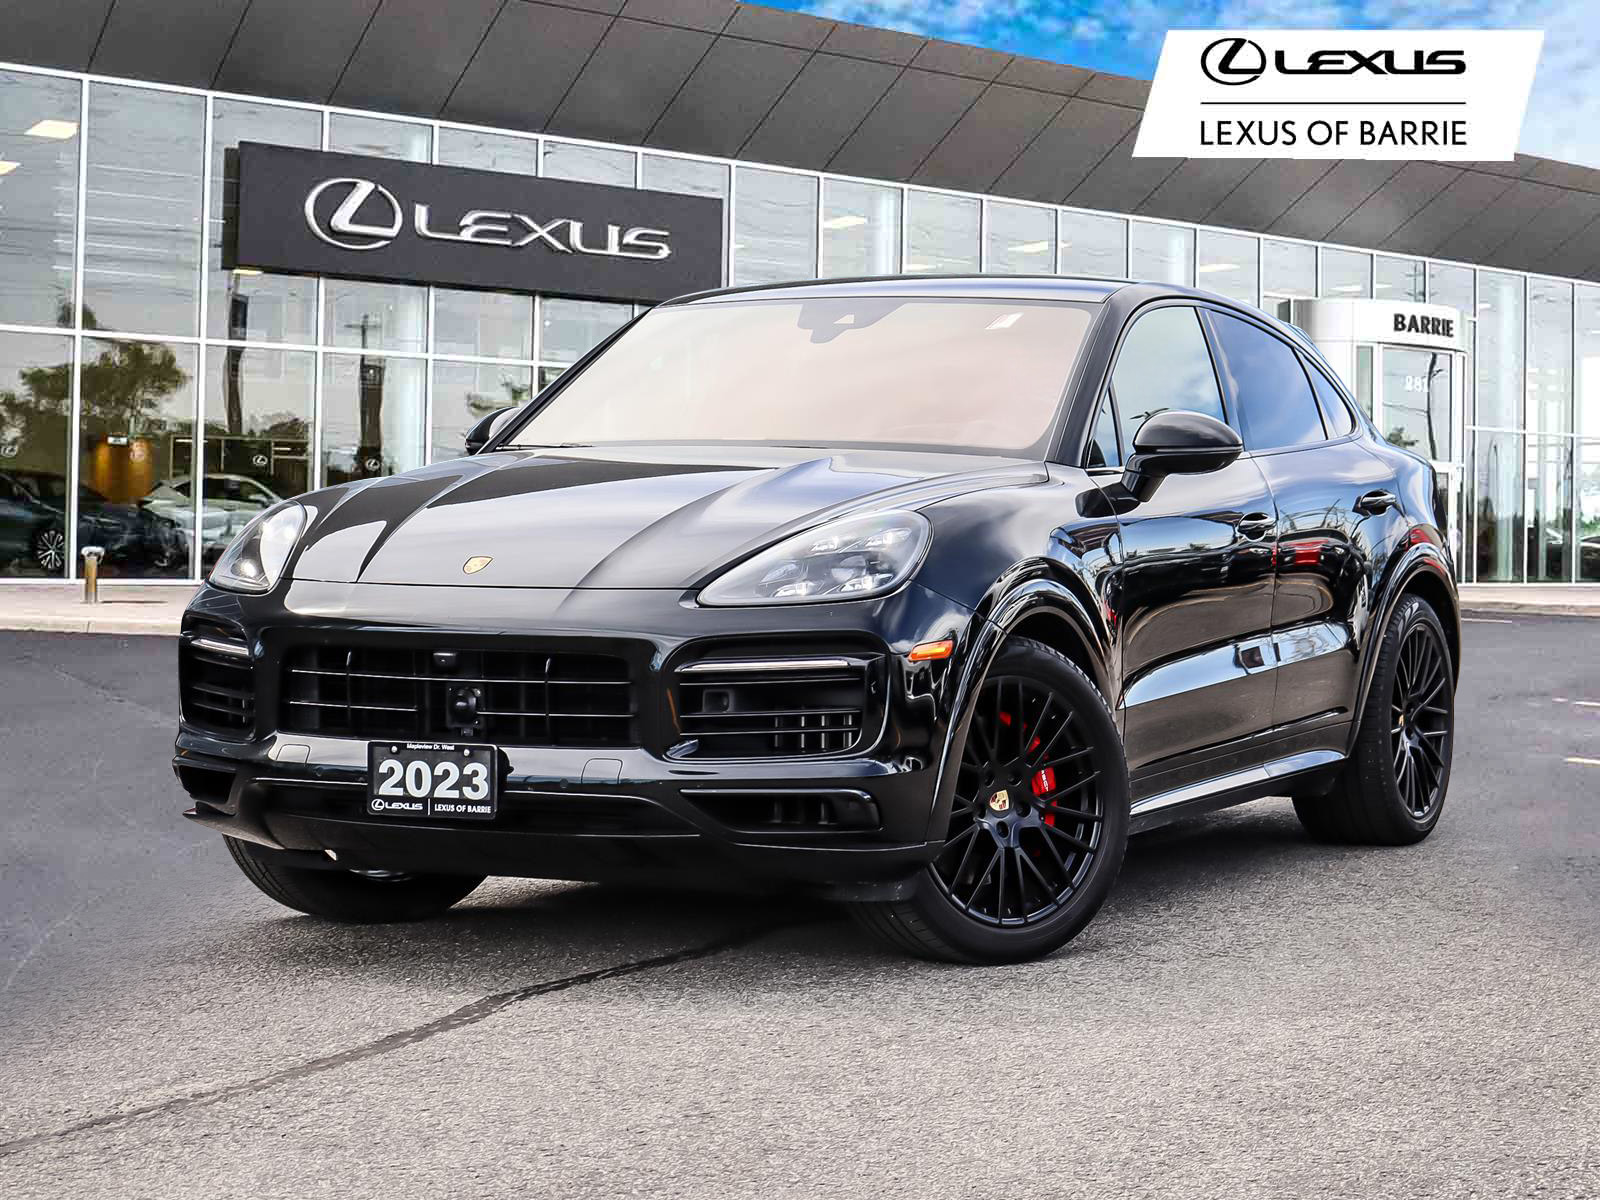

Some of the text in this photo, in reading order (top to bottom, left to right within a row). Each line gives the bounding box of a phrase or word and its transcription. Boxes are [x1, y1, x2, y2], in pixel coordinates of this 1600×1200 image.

[415, 204, 672, 259] LEXUS
[1393, 313, 1454, 338] BARRIE
[378, 759, 489, 800] 2023
[385, 802, 423, 810] LEXUS
[435, 804, 455, 812] LEXUS
[468, 805, 491, 813] BARRIE
